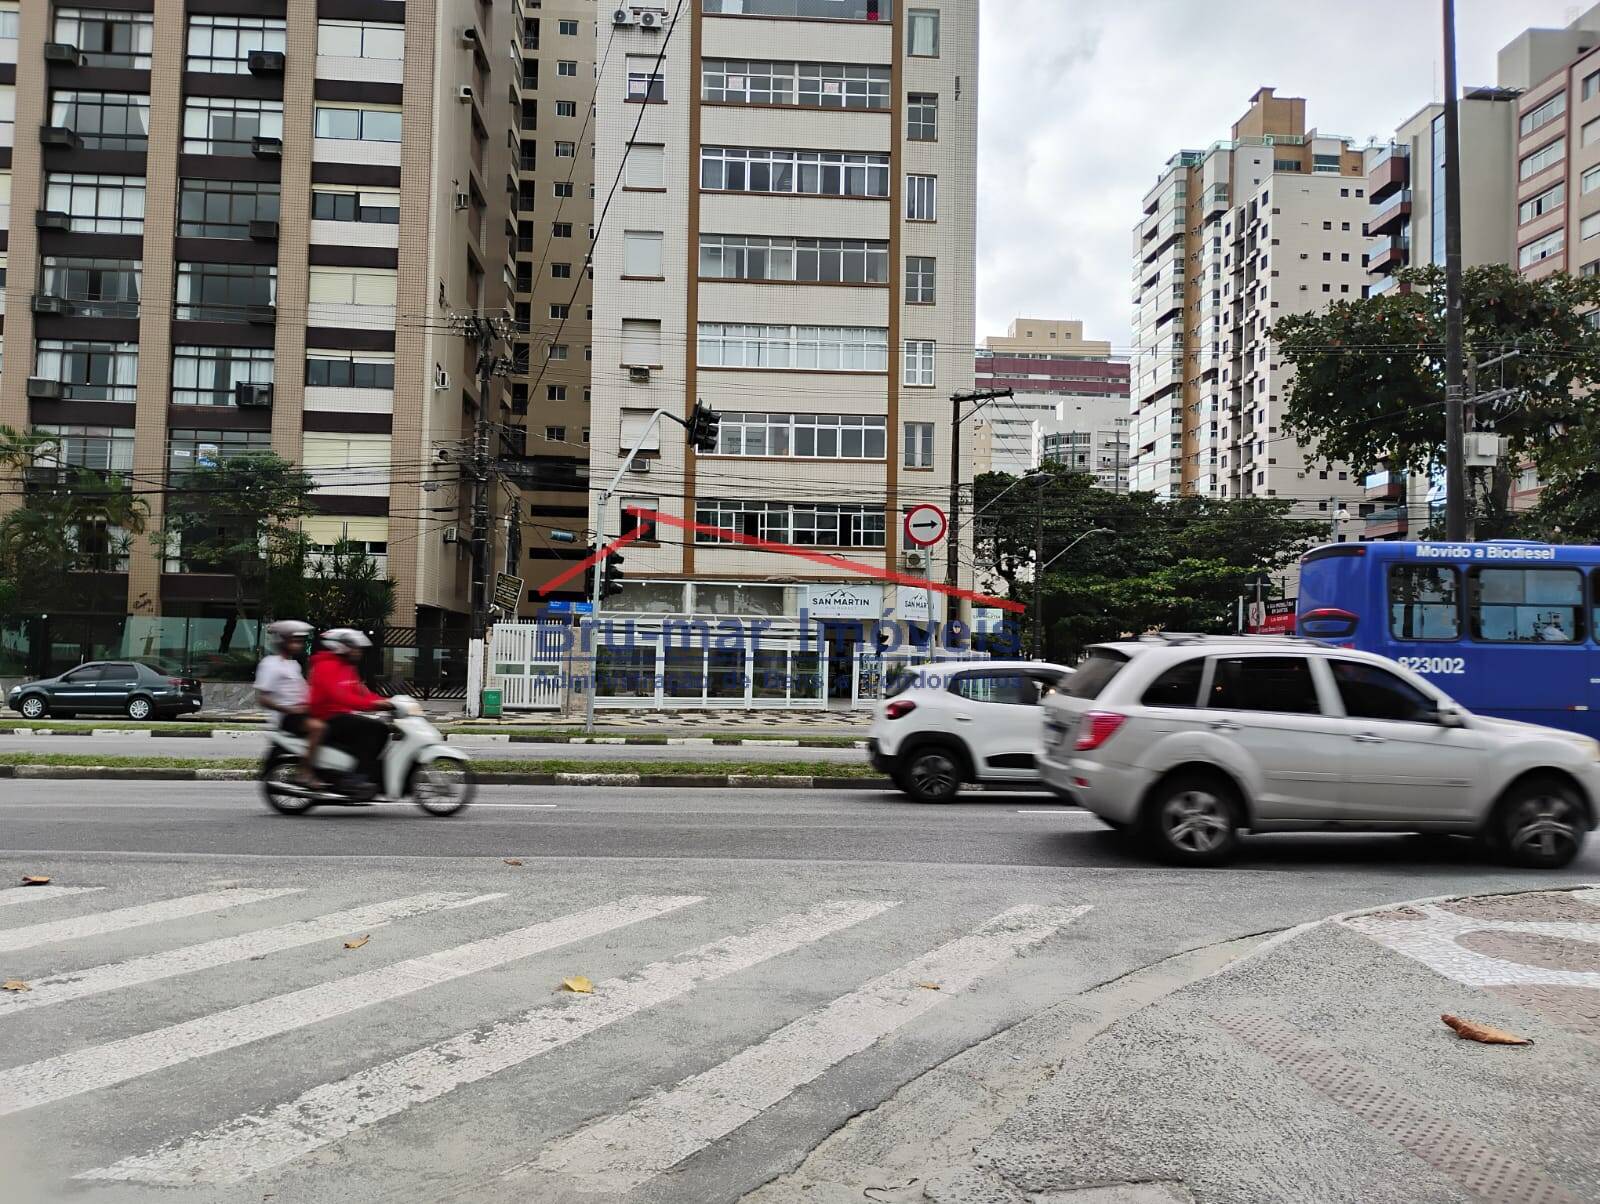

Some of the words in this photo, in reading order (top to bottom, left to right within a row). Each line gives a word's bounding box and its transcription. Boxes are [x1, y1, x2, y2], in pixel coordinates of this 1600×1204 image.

[1416, 545, 1471, 558] Movido
[1474, 548, 1484, 558] a
[1486, 546, 1555, 560] Biodiesel
[833, 598, 870, 606] MARTIN
[904, 600, 915, 608] SAN
[1398, 656, 1465, 674] 823002
